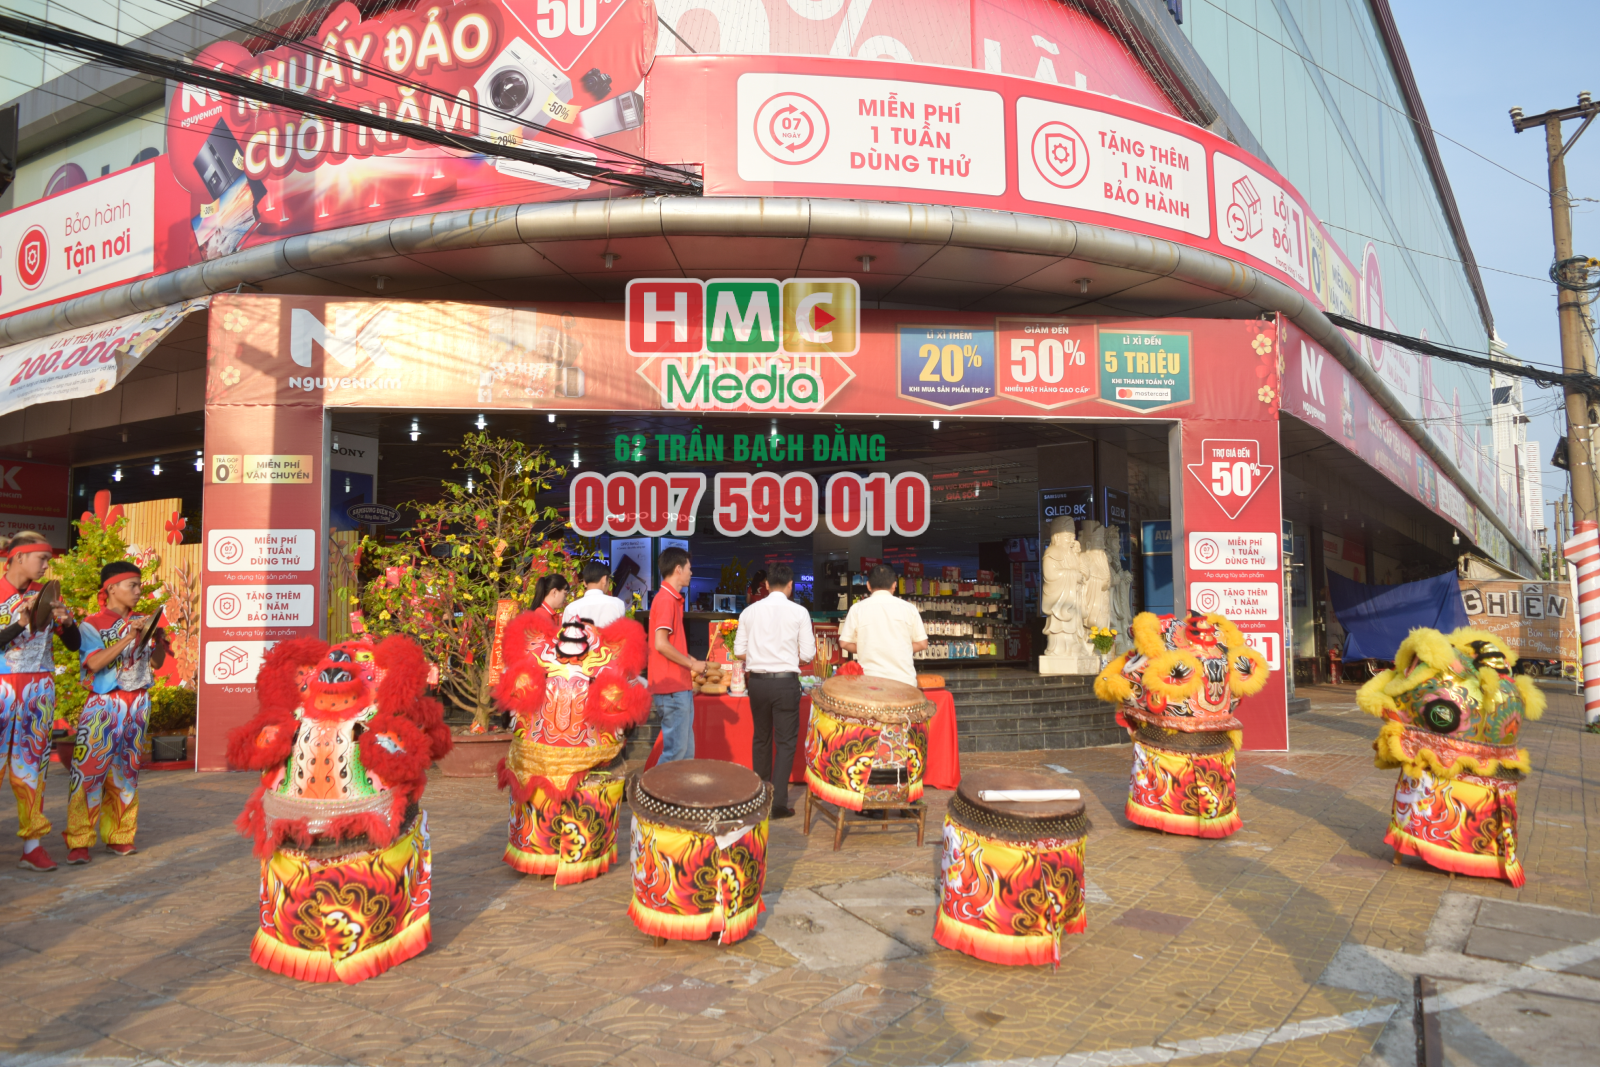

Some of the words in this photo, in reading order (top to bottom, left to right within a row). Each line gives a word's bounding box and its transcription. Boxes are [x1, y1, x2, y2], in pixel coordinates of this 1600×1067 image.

[537, 0, 612, 38] 50
[384, 7, 492, 72] ĐẢO
[547, 101, 570, 121] -50%
[858, 91, 916, 120] MIỄN
[924, 101, 962, 124] PHÍ
[246, 95, 342, 175] CUỐI
[358, 84, 473, 148] NĂM
[781, 117, 802, 130] 07
[782, 131, 802, 139] NGÀY
[870, 126, 879, 143] 1
[890, 121, 951, 150] TUẦN
[1098, 129, 1145, 158] TẶNG
[1150, 146, 1190, 172] THÊM
[850, 147, 920, 173] DÙNG
[927, 153, 972, 178] THỬ
[1121, 162, 1128, 179] 1
[1136, 165, 1173, 190] NĂM
[1103, 179, 1140, 206] BẢO
[1145, 191, 1190, 219] HÀNH
[1273, 191, 1290, 225] LỖI
[65, 212, 91, 236] Bảo
[95, 199, 131, 227] hành
[1272, 224, 1292, 258] ĐỔI
[1292, 208, 1304, 269] 1
[64, 241, 96, 275] Tận
[102, 228, 131, 259] nơi
[926, 330, 934, 339] LÌ
[936, 330, 946, 340] XÌ
[949, 330, 973, 340] THÊM
[1024, 324, 1049, 334] GIẢM
[1051, 323, 1069, 335] ĐẾN
[290, 308, 402, 369] NK
[1123, 336, 1130, 345] LÌ
[1133, 336, 1142, 345] XÌ
[1144, 335, 1162, 346] ĐẾN
[919, 343, 982, 383] 20%
[1010, 338, 1086, 384] 50%
[1105, 351, 1118, 373] 5
[1124, 349, 1180, 378] TRIỆU
[1301, 339, 1325, 406] NK
[1144, 377, 1162, 386] TOÁN
[1163, 378, 1175, 386] VỚI
[937, 385, 950, 393] SẢN
[951, 384, 970, 394] PHẨM
[971, 385, 984, 394] THỨ
[1005, 384, 1024, 393] NHIỀU
[1025, 385, 1038, 394] MẶT
[1039, 385, 1058, 393] HÀNG
[1134, 390, 1169, 398] mastercard
[330, 446, 366, 458] SONY
[1212, 448, 1225, 459] TRỢ
[1226, 447, 1236, 458] GIÁ
[1237, 447, 1250, 458] ĐẾN
[256, 459, 281, 469] MIỄN
[283, 460, 301, 469] PHÍ
[216, 464, 239, 482] 0%
[246, 470, 267, 480] VẬN
[270, 469, 310, 480] CHUYỂN
[1212, 461, 1260, 498] 50%
[1045, 504, 1071, 516] QLED
[1073, 504, 1086, 514] 8K
[8, 521, 36, 530] TRUNG
[38, 522, 55, 531] TÂM
[254, 534, 278, 544] MIỄN
[281, 535, 297, 544] PHÍ
[1228, 536, 1247, 546] MIỄN
[1250, 537, 1262, 546] PHÍ
[267, 543, 292, 555] TUẦN
[1238, 545, 1259, 555] TUẦN
[250, 555, 279, 565] DÙNG
[282, 555, 301, 565] THỬ
[1225, 556, 1249, 565] DÙNG
[1249, 556, 1266, 565] THỬ
[246, 591, 273, 602] TẶNG
[276, 591, 301, 600] THÊM
[1223, 588, 1245, 599] TẶNG
[1247, 588, 1268, 596] THÊM
[266, 601, 289, 611] NĂM
[1240, 597, 1258, 606] NĂM
[1465, 584, 1566, 617] GHIỀN
[247, 611, 268, 621] BẢO
[271, 611, 299, 621] HÀNH
[1225, 607, 1244, 615] BẢO
[1246, 607, 1267, 615] HÀNH
[1262, 637, 1273, 662] 1
